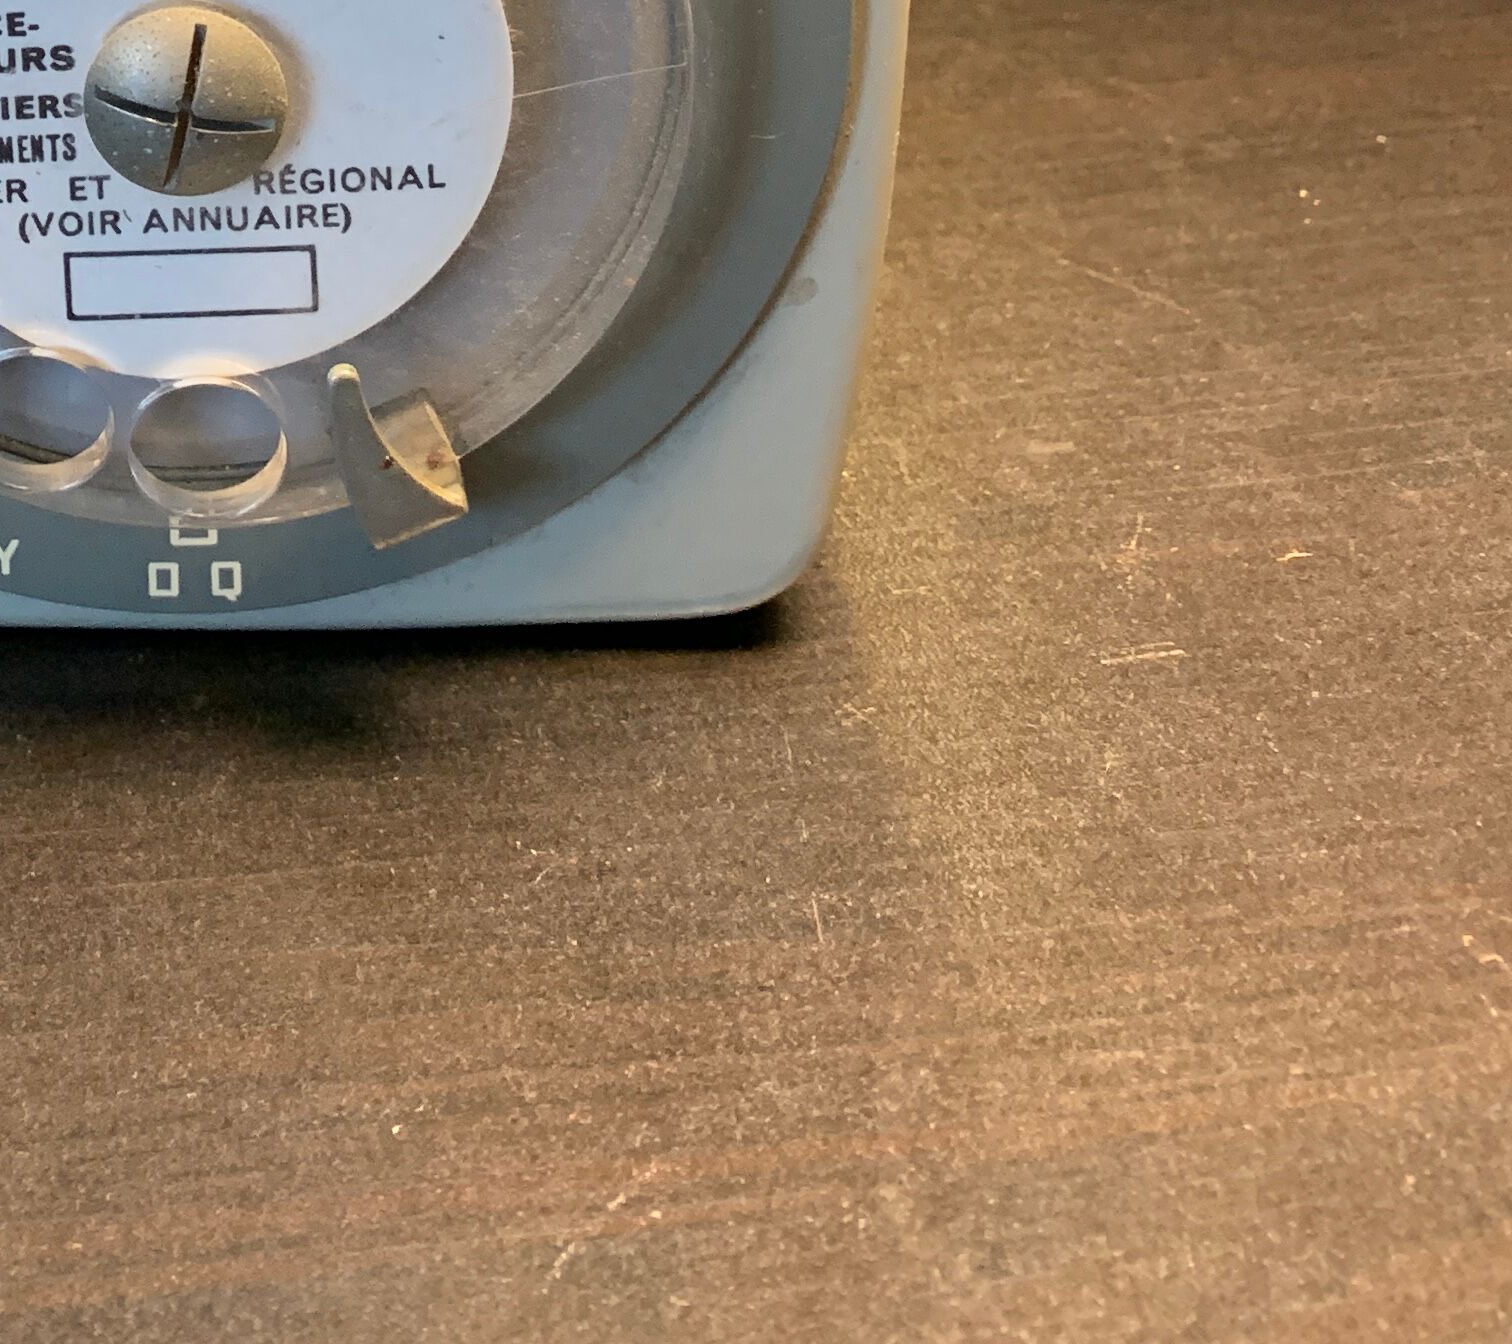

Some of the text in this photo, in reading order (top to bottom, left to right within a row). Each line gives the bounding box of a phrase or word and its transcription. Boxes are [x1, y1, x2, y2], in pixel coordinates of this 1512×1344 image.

[69, 174, 112, 203] ET
[253, 164, 447, 196] RÉGIONAL
[18, 203, 353, 244] (VOIR ANNUAIRE)
